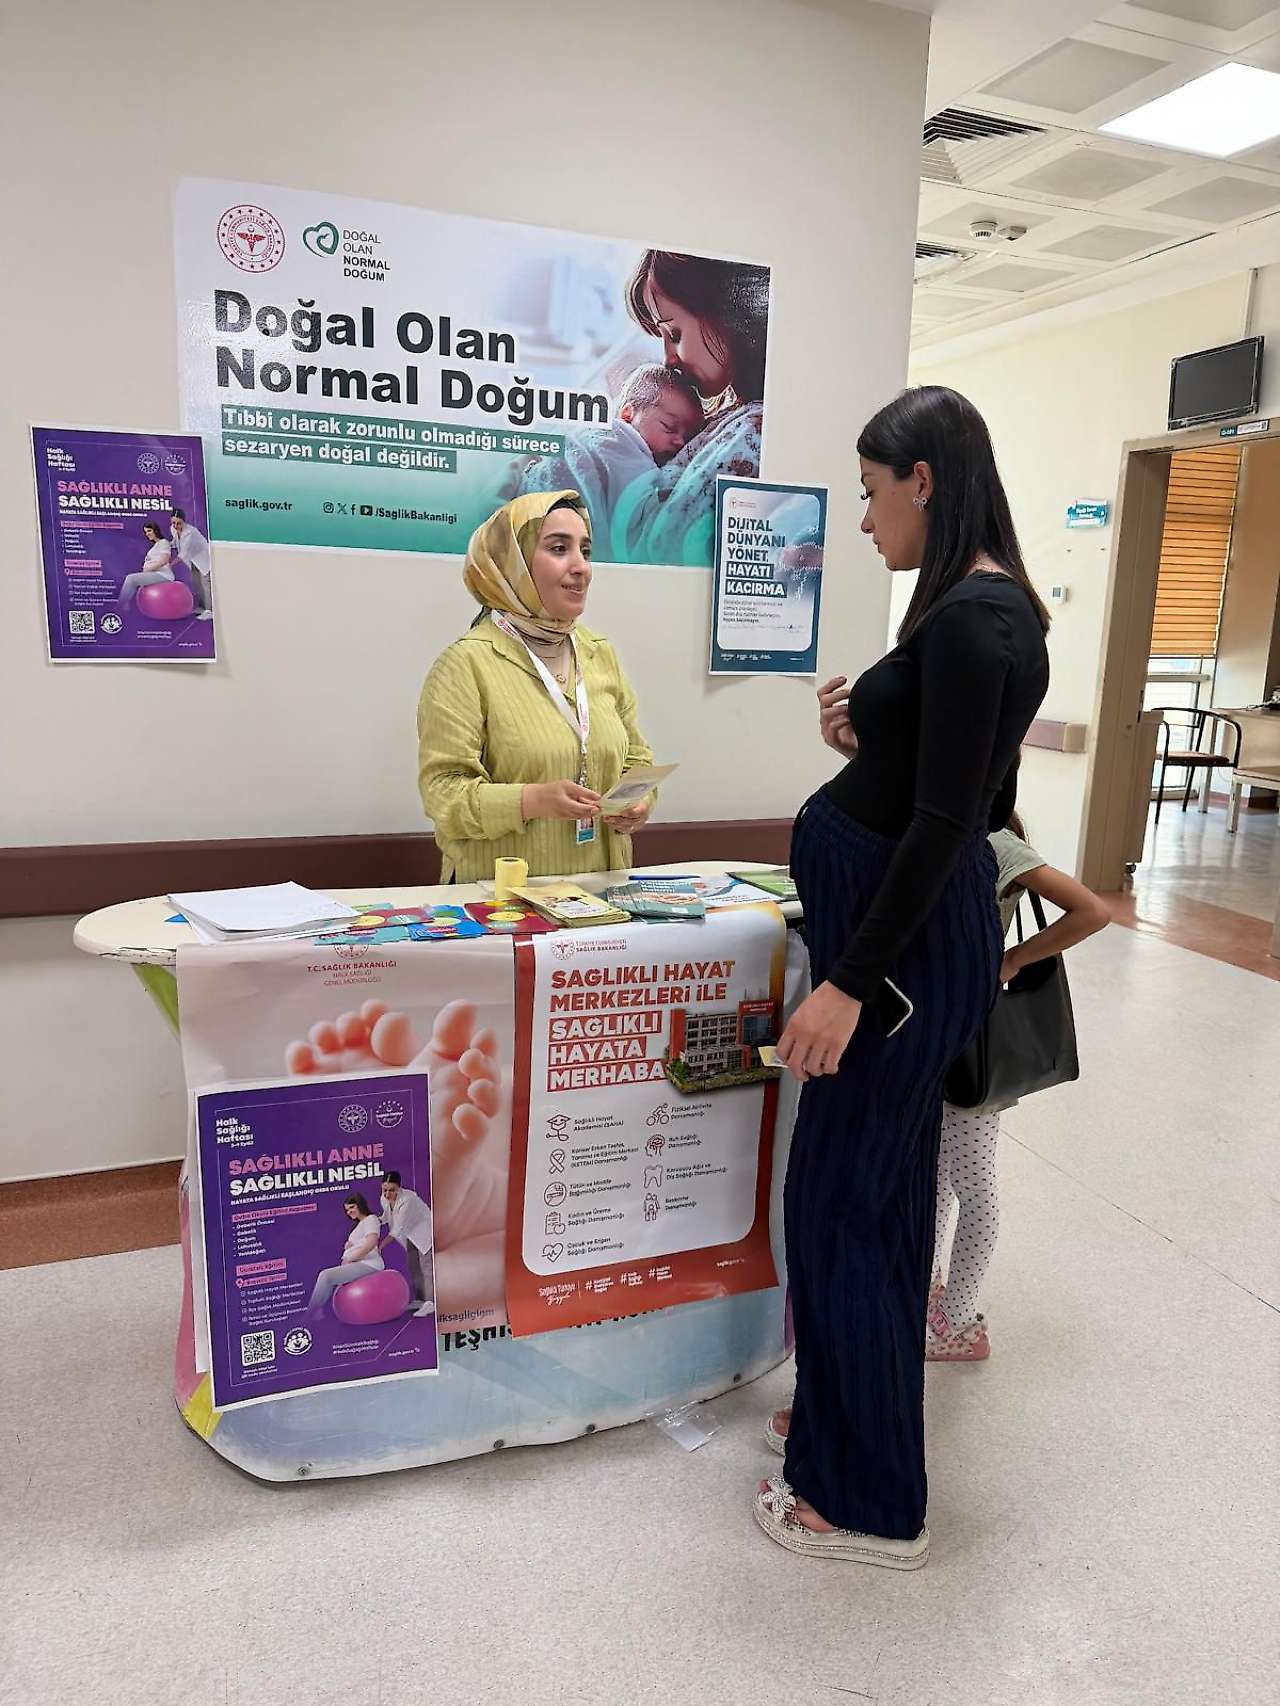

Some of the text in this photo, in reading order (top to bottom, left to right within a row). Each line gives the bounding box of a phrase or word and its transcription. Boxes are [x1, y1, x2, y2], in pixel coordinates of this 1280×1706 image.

[343, 229, 381, 244] DOĞAL
[343, 243, 372, 255] OLAN
[343, 256, 390, 270] NORMAL
[344, 267, 385, 281] DOĞUM
[214, 289, 515, 363] Doğal Olan
[216, 346, 609, 425] Normal Doğum
[224, 408, 560, 454] Tıbbi olarak zorunlu olmadığı sürece
[224, 439, 450, 469] sezaryen doğal değildir.
[57, 480, 172, 496] SAĞLIKLI ANNE
[58, 495, 173, 511] SAĞLIKLI NESİL
[225, 498, 293, 511] saglik.gov.tr
[727, 530, 785, 547] DÜNYANI
[728, 563, 770, 578] HAYATI
[664, 960, 735, 980] HAYAT
[550, 983, 727, 1012] MERKEZLERİ İLE
[551, 1040, 642, 1065] HAYATA
[551, 1061, 665, 1090] MERHABA
[216, 1118, 238, 1127] Halk
[216, 1124, 251, 1135] Sağlığı
[217, 1133, 254, 1144] Haftası
[228, 1143, 384, 1176] SAĞLIKLI ANNE
[229, 1161, 385, 1196] SAĞLIKLI NESİL
